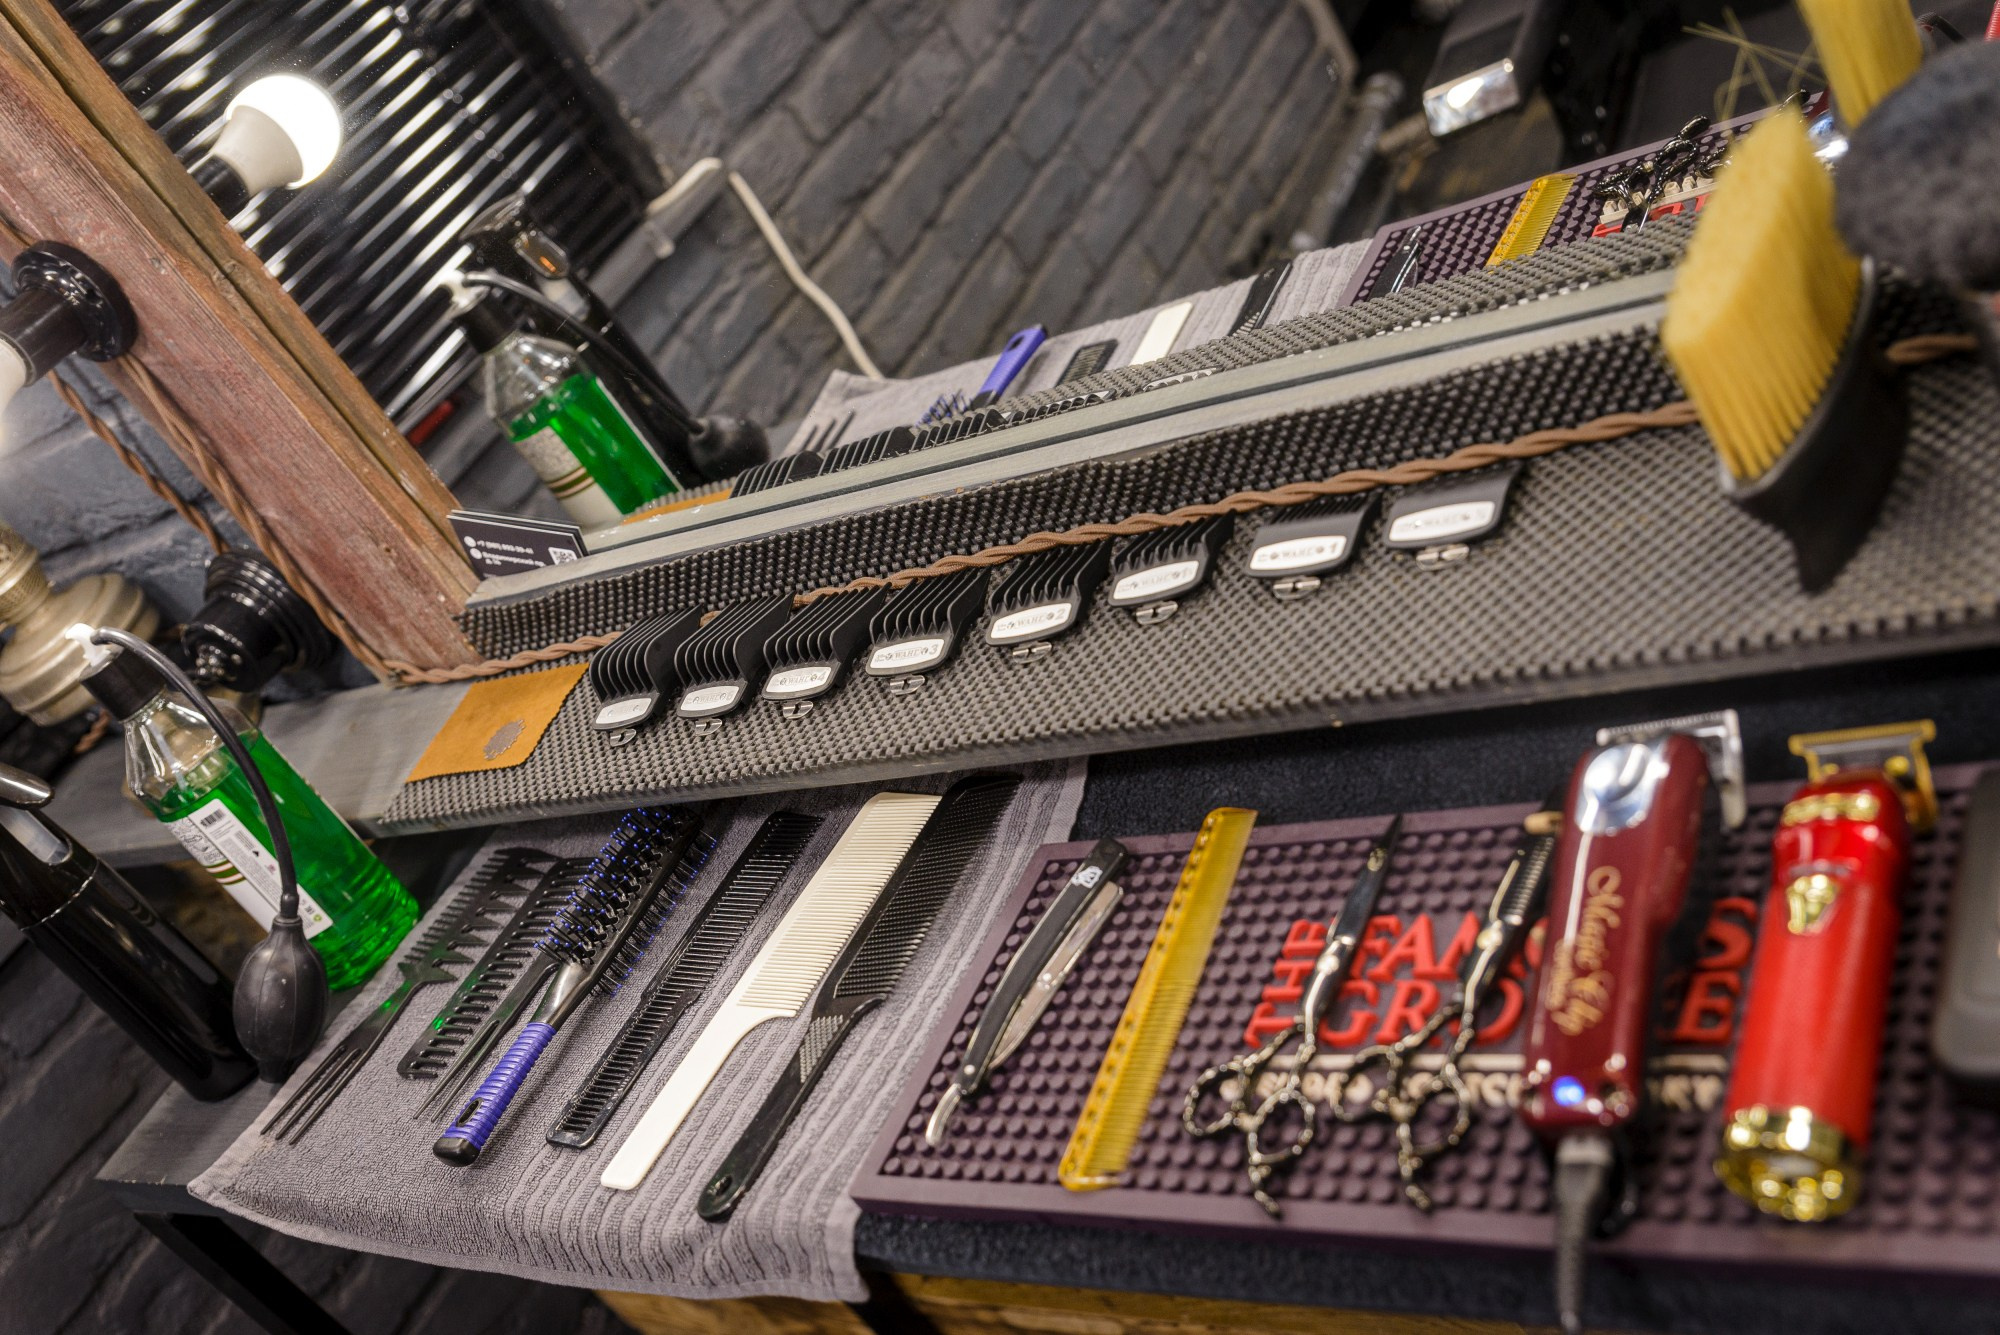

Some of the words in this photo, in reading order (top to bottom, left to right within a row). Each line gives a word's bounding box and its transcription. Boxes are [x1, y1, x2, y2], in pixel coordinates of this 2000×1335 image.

[1017, 615, 1046, 627] WAHL
[1055, 608, 1066, 620] 2
[895, 648, 920, 659] WAHL
[928, 644, 939, 656] 3
[788, 674, 811, 684] WAHL
[816, 670, 827, 681] 4
